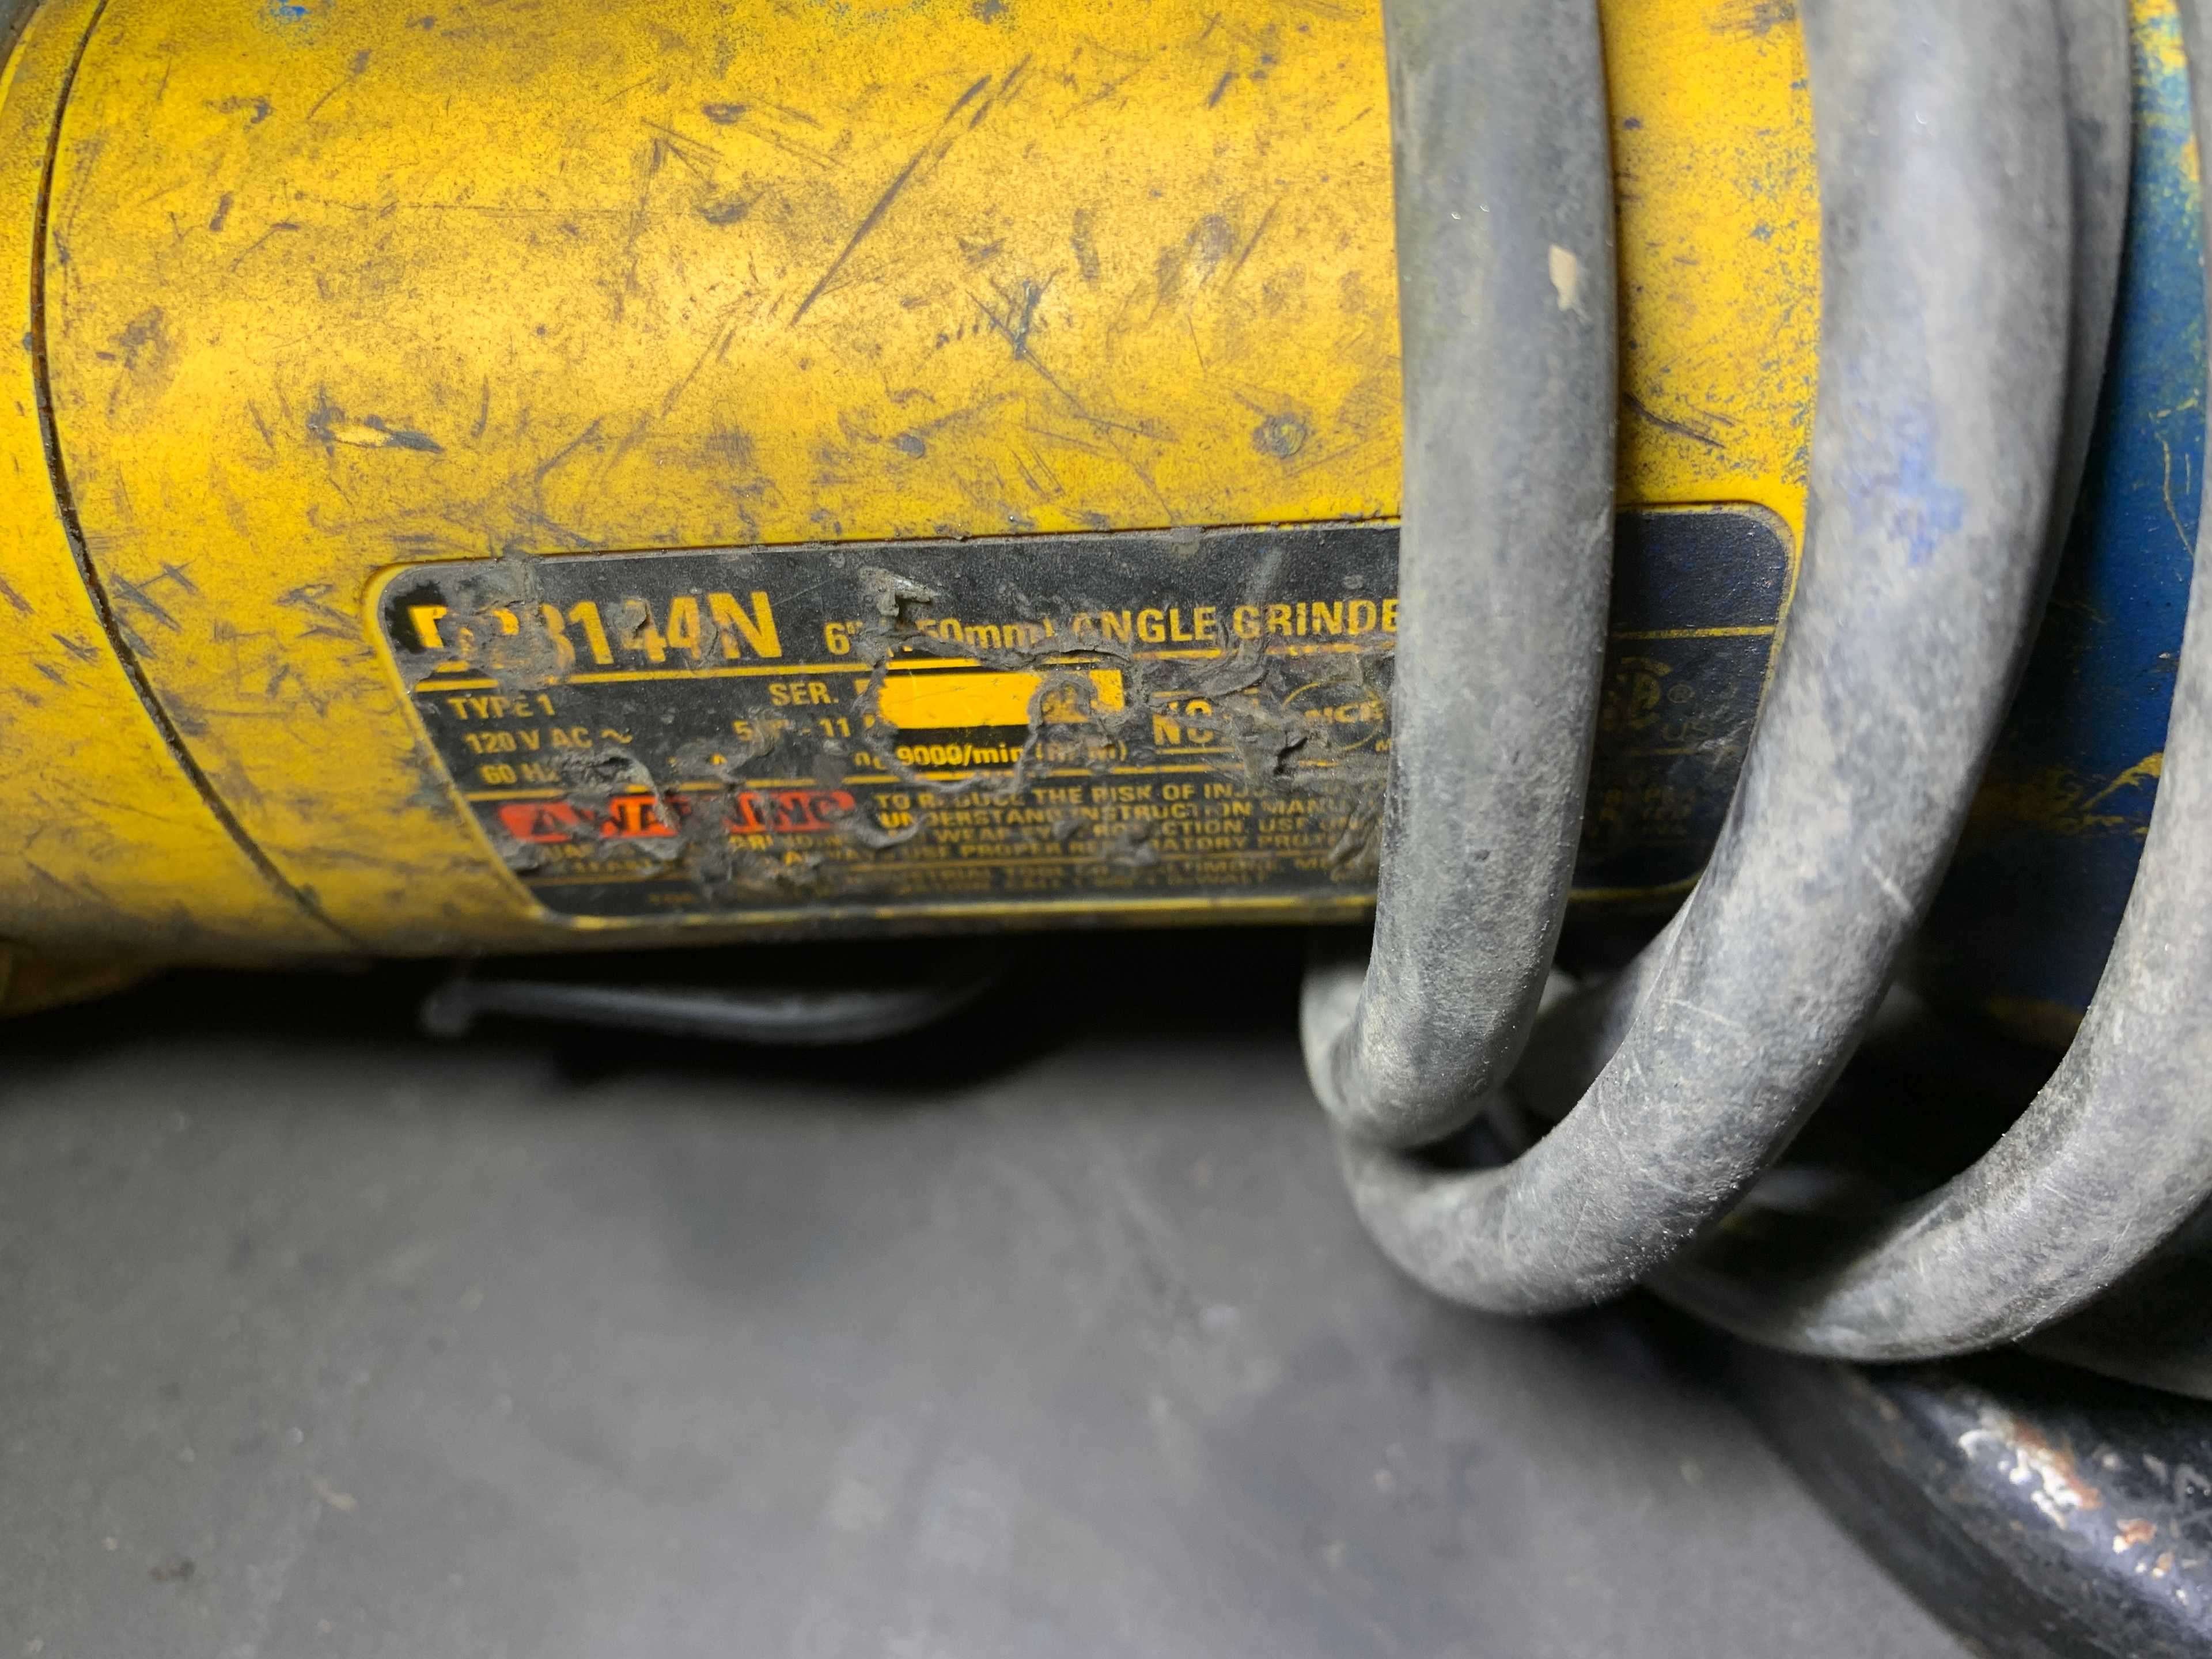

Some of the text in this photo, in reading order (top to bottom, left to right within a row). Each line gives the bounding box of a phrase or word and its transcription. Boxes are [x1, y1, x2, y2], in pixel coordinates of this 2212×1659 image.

[1072, 605, 1217, 644] ANGLE
[1233, 599, 1400, 639] GRINDE
[768, 681, 839, 706] SER.
[447, 694, 555, 720] TYPE 1
[464, 730, 517, 755] 120
[518, 729, 540, 751] V
[550, 726, 593, 749] AC
[896, 743, 1024, 767] 9000/min
[479, 763, 517, 784] 60
[875, 792, 911, 810] TO
[1032, 786, 1084, 805] THE
[1090, 784, 1152, 803] RISK
[1161, 783, 1196, 801] OF
